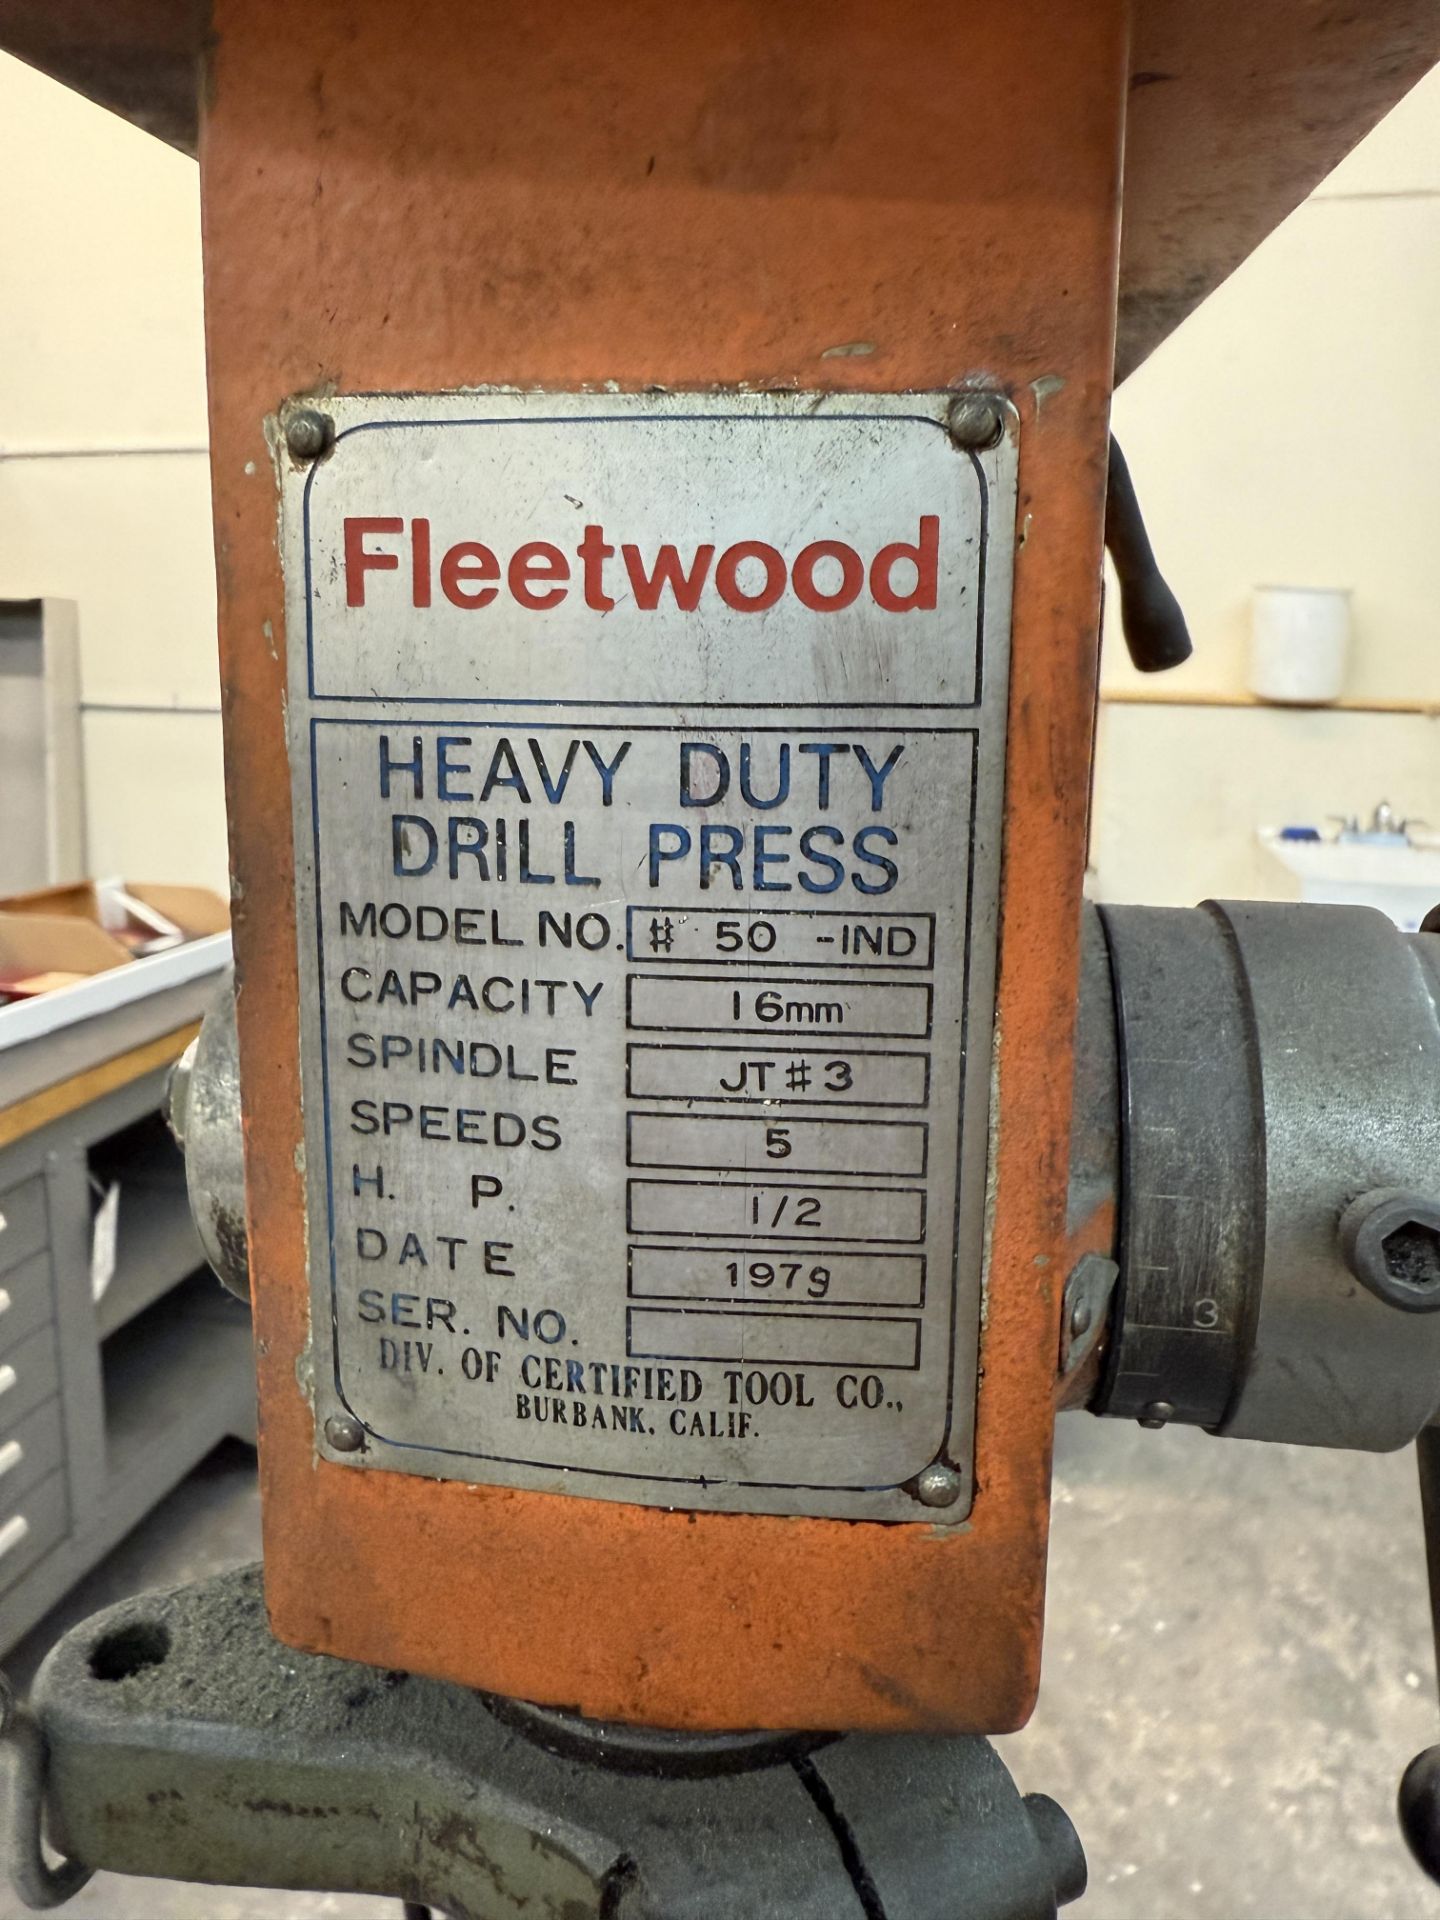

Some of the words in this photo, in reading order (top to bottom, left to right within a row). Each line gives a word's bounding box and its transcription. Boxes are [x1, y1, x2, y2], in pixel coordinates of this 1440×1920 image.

[343, 515, 940, 613] Fleetwood
[379, 735, 632, 807] HEAVY
[679, 742, 904, 812] DUTY
[392, 815, 601, 886] DRILL
[649, 823, 899, 895] PRESS
[340, 901, 524, 946] MODEL
[538, 910, 624, 951] NO.
[649, 916, 674, 953] #
[716, 920, 777, 952] 50
[816, 924, 917, 957] -IND
[341, 967, 604, 1017] CAPACITY
[733, 990, 844, 1023] 16mm
[347, 1033, 578, 1085] SPINDLE
[350, 1100, 562, 1151] SPEEDS
[766, 1128, 792, 1159] 5
[352, 1164, 396, 1200] H.
[471, 1174, 515, 1212] P.
[753, 1195, 822, 1228] 1/2
[356, 1227, 516, 1277] DATE
[726, 1262, 831, 1298] 1979
[357, 1289, 470, 1335] SER.
[497, 1305, 578, 1345] NO.
[379, 1337, 444, 1375] DIV.
[461, 1347, 501, 1383] OF
[521, 1354, 703, 1403] CERTIFIED
[724, 1370, 815, 1408] TOOL
[836, 1374, 903, 1413] CO.,
[669, 1408, 760, 1439] CALIF.
